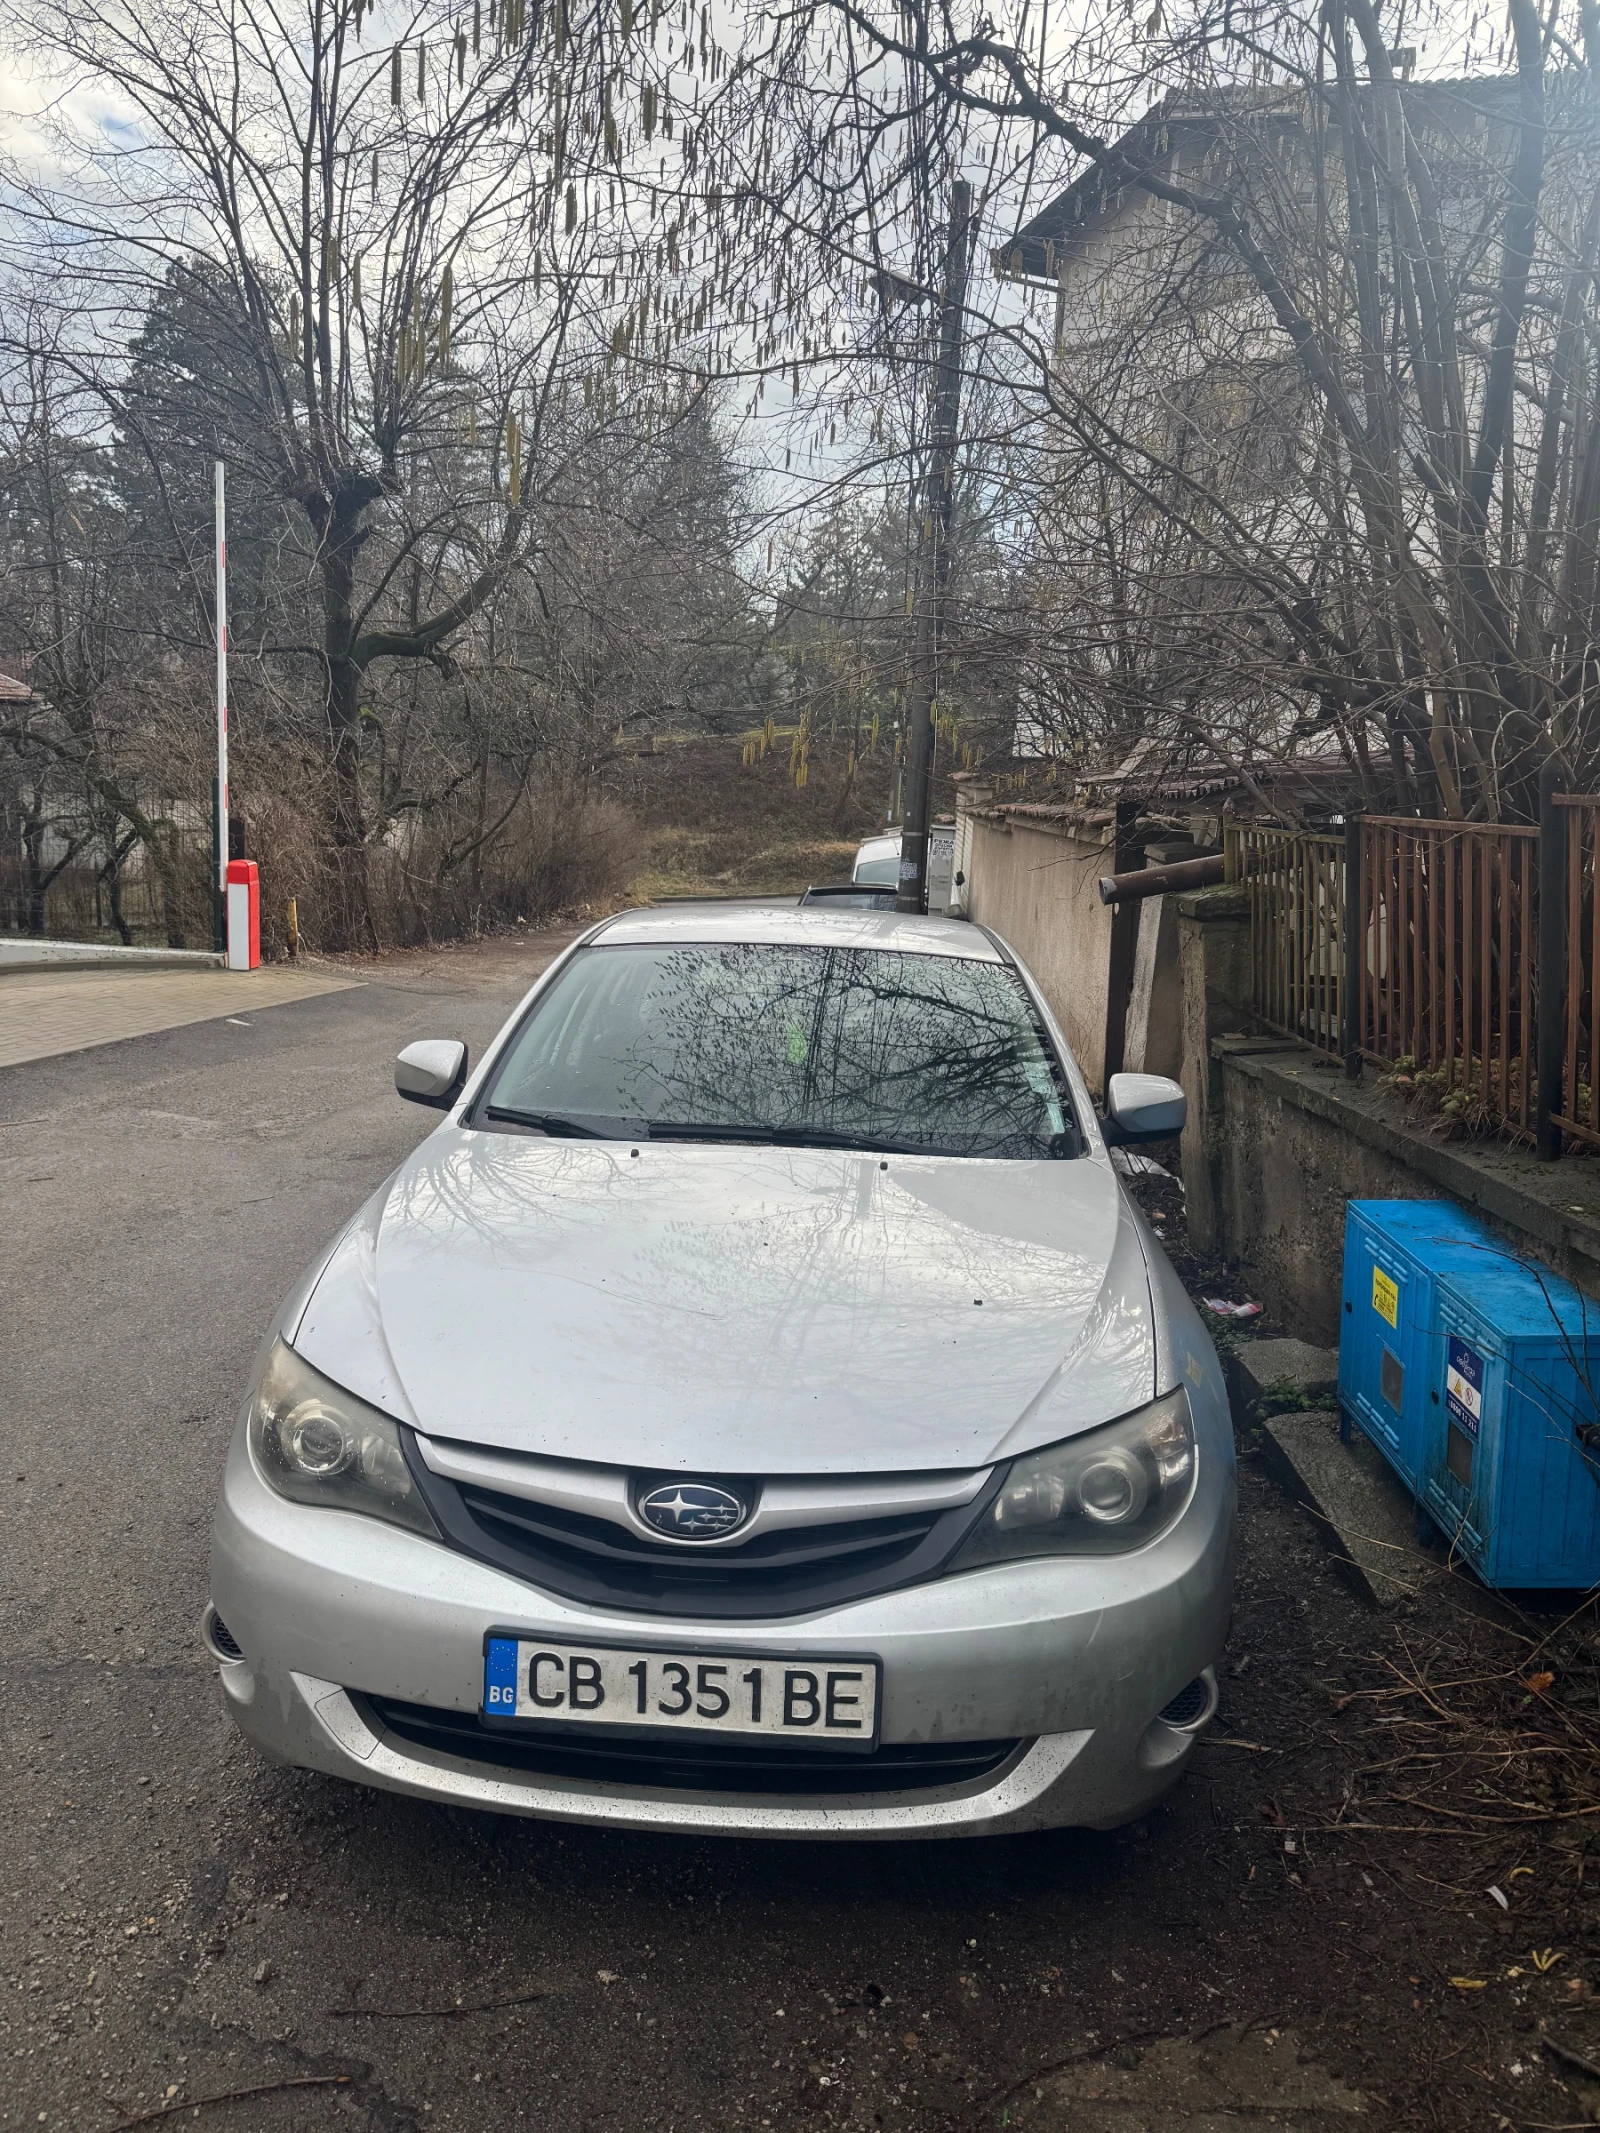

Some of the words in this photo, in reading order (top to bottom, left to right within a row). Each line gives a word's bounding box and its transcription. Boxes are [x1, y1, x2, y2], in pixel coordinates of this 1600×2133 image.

[489, 1685, 514, 1704] BG
[528, 1651, 606, 1710] CB
[627, 1659, 762, 1723] 1351
[783, 1669, 863, 1728] BE
